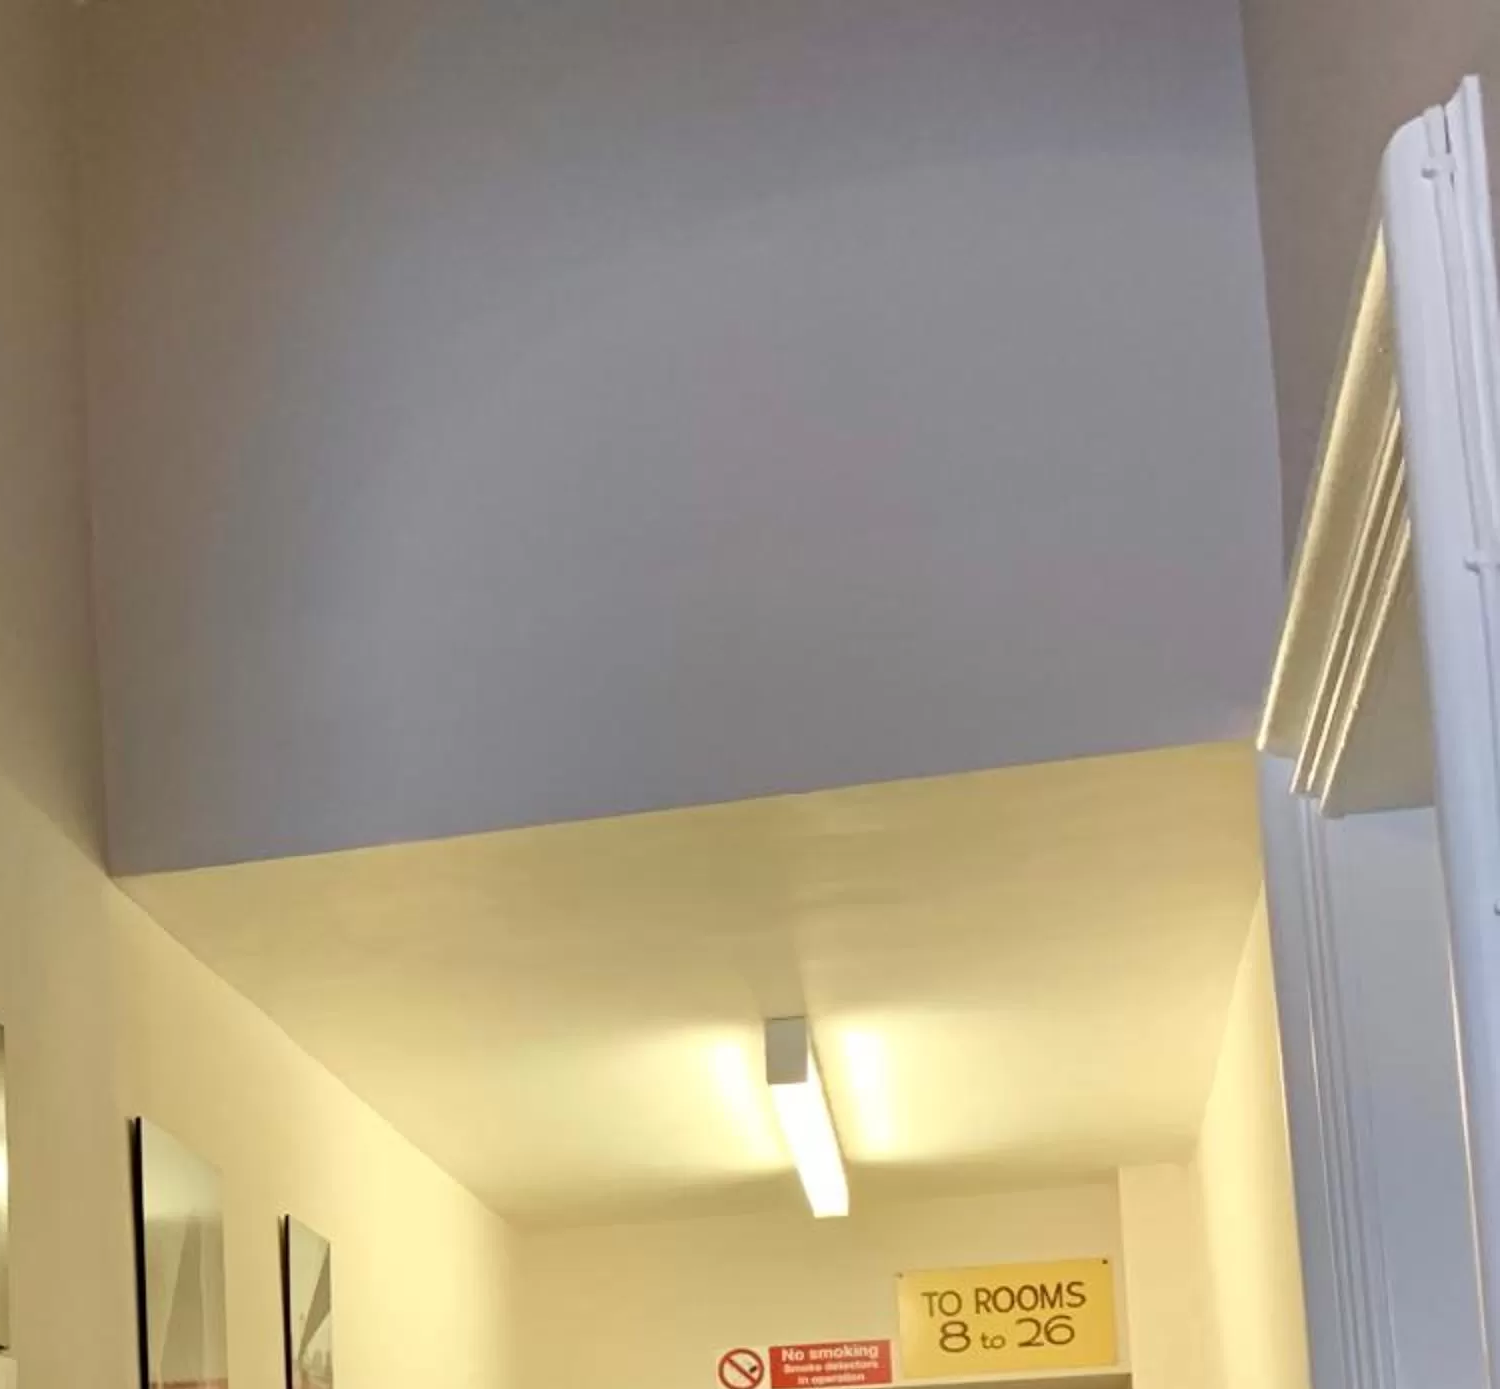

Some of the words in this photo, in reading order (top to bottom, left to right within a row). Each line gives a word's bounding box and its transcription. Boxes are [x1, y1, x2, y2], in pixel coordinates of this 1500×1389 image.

[921, 1290, 962, 1317] TO
[975, 1281, 1086, 1314] ROOMS
[939, 1321, 971, 1352] 8
[980, 1332, 1006, 1349] to
[1015, 1315, 1075, 1347] 26
[781, 1348, 805, 1362] No
[809, 1344, 879, 1360] smoking
